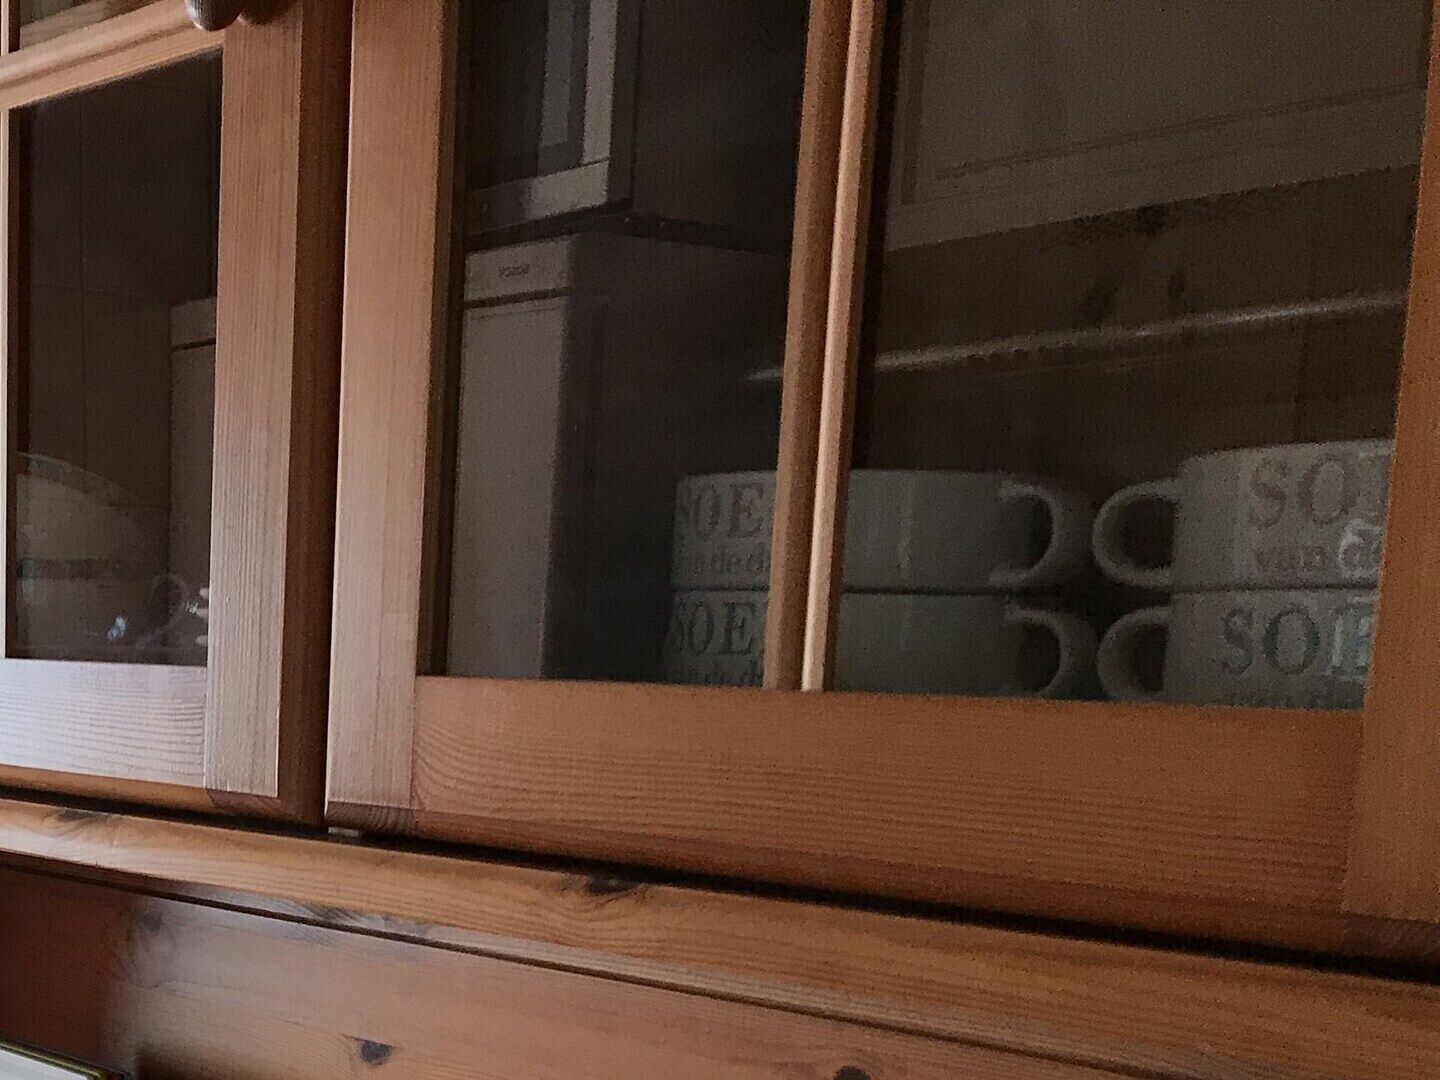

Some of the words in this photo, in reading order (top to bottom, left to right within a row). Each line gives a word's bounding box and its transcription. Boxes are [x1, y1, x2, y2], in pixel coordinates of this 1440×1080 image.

[677, 481, 770, 541] SOE
[1251, 453, 1389, 528] SO
[669, 601, 764, 656] SOE
[1222, 603, 1372, 676] SOE
